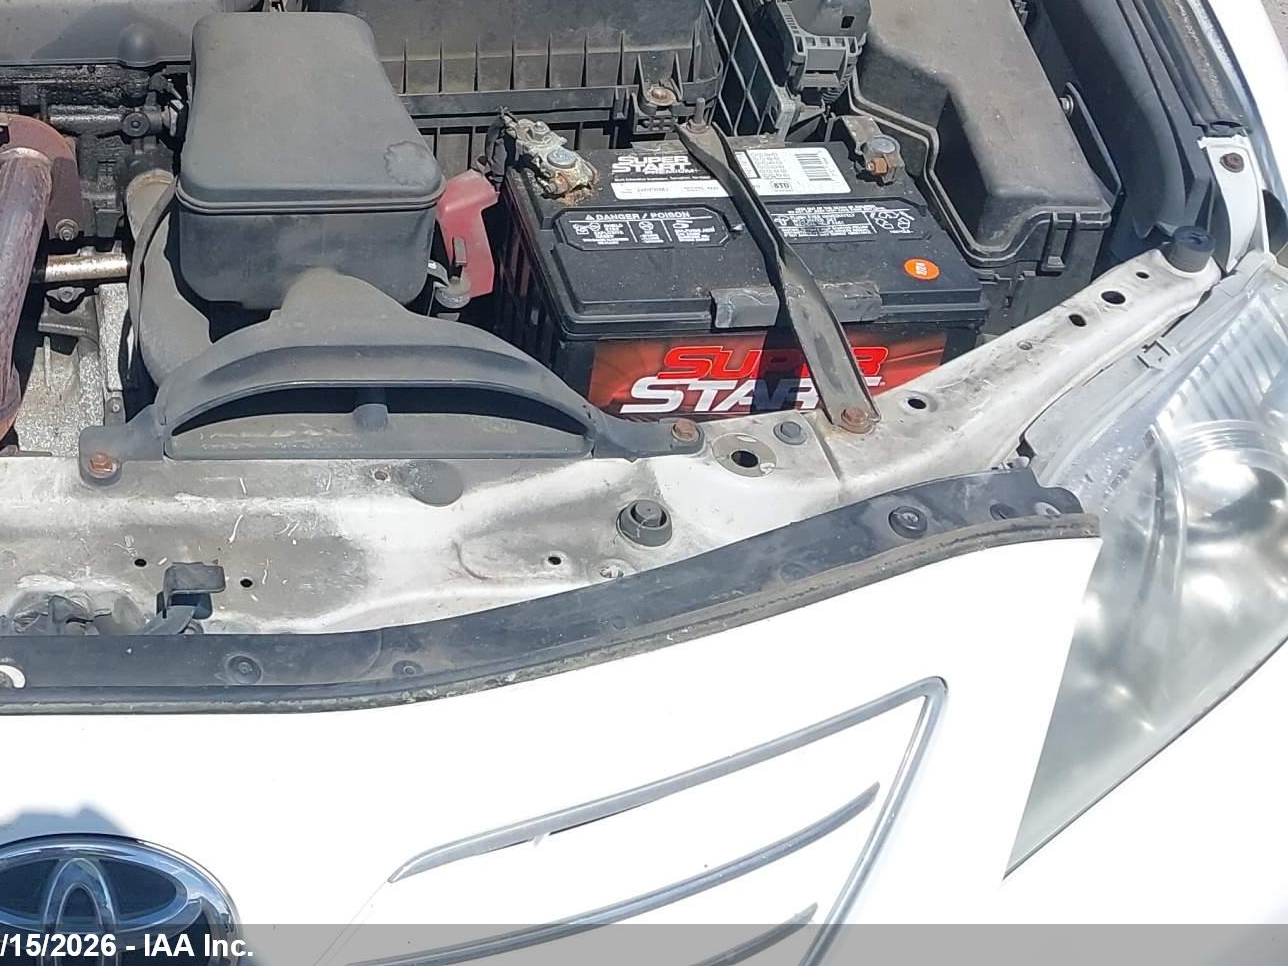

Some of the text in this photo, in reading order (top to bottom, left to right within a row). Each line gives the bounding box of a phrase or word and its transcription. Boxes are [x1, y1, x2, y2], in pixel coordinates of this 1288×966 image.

[616, 155, 689, 165] SUPER
[611, 163, 692, 174] START
[596, 212, 641, 221] DANGER
[650, 210, 691, 219] POISON
[657, 345, 889, 379] SUPR
